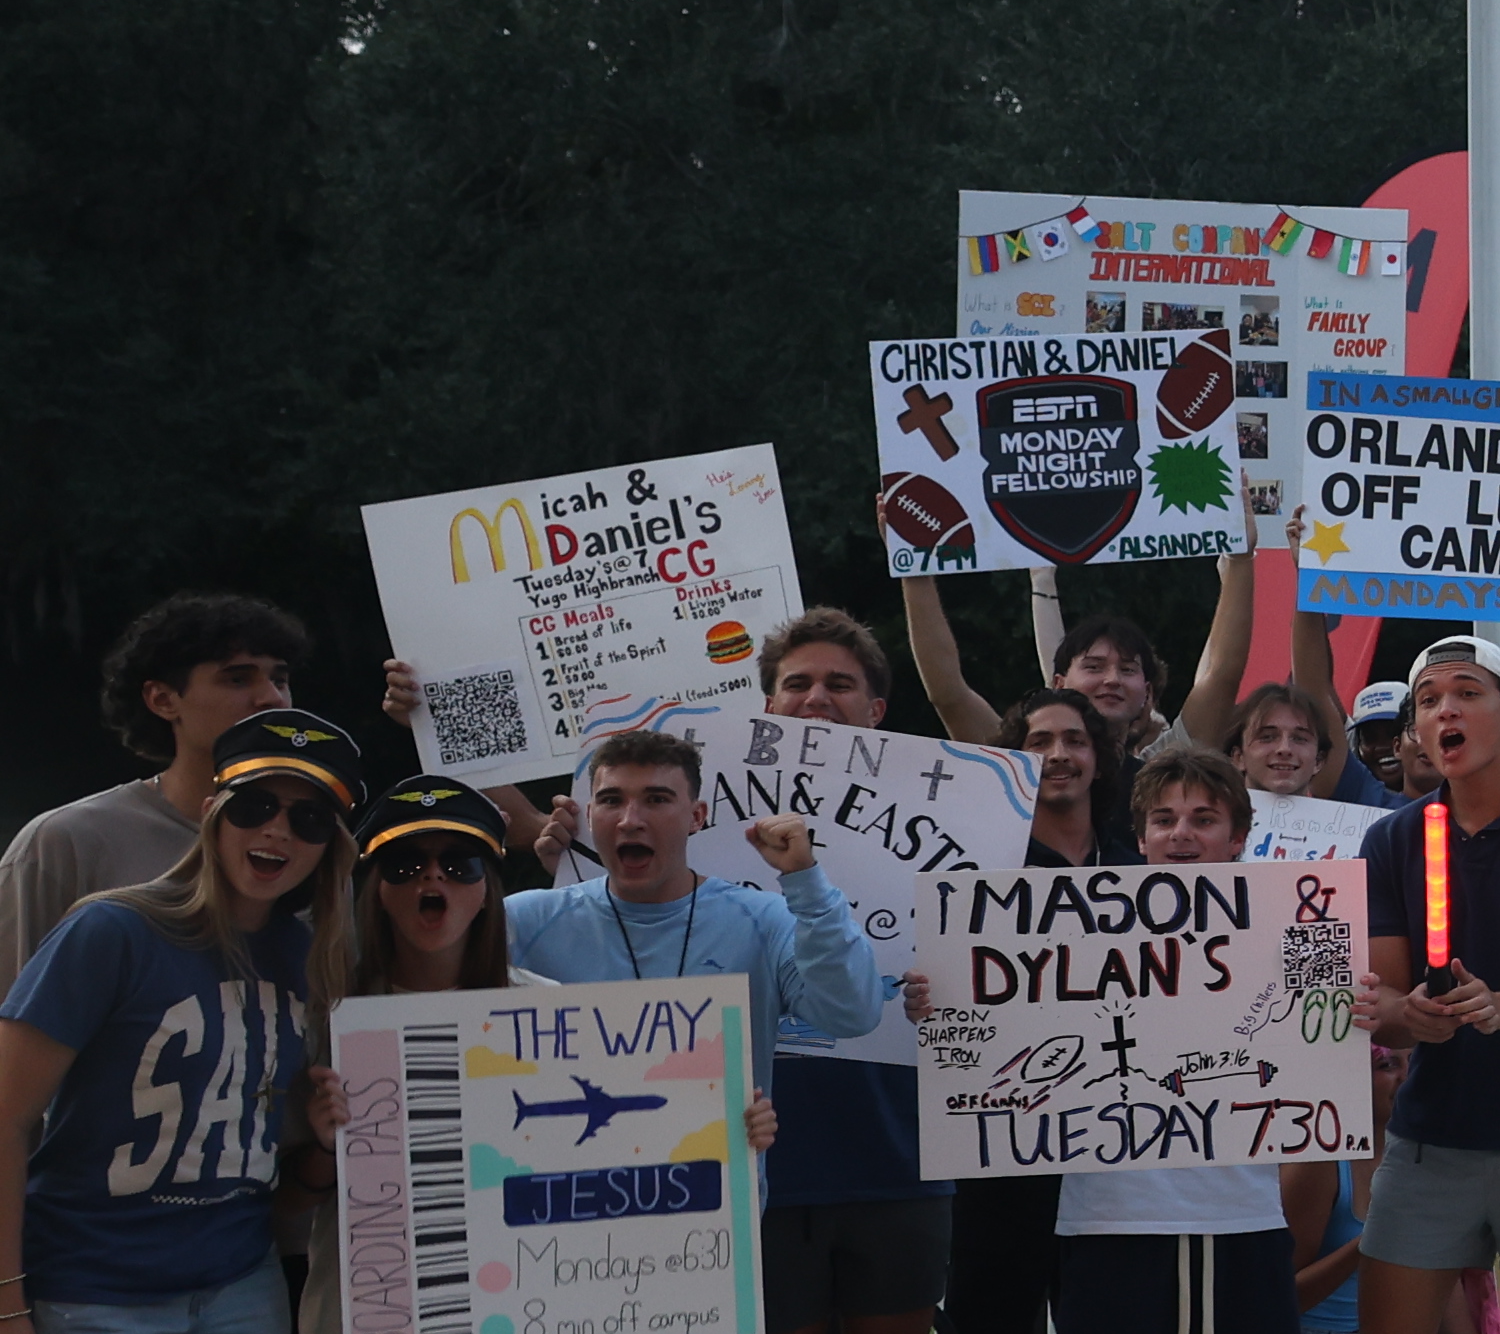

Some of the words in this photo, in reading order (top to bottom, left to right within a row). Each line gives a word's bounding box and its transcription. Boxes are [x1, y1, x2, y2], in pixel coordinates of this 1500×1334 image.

[1307, 312, 1370, 333] FAMILY
[881, 340, 1038, 383] CHRISTIAN
[1046, 340, 1073, 373] &
[1078, 337, 1178, 374] DANIEL
[1334, 338, 1387, 358] GROUP
[1013, 395, 1099, 422] ESPN
[1000, 427, 1124, 454] MONDAY
[1018, 452, 1106, 472] NIGHT
[991, 468, 1138, 494] FELLOWSHIP
[1321, 472, 1421, 520] OFF
[545, 496, 721, 566] Daniel's
[1119, 530, 1231, 559] ALSANDER
[528, 591, 568, 609] Yugo
[574, 569, 660, 598] Highbranch
[676, 578, 731, 601] Drinks
[969, 871, 1250, 935] MASON
[972, 931, 1232, 1005] DYLAN'S
[490, 1007, 581, 1061] THE
[593, 998, 712, 1056] WAY
[918, 1023, 996, 1046] SHARPENS
[976, 1100, 1220, 1167] TUESDAY
[532, 1162, 690, 1224] JESUS
[604, 1301, 642, 1334] off
